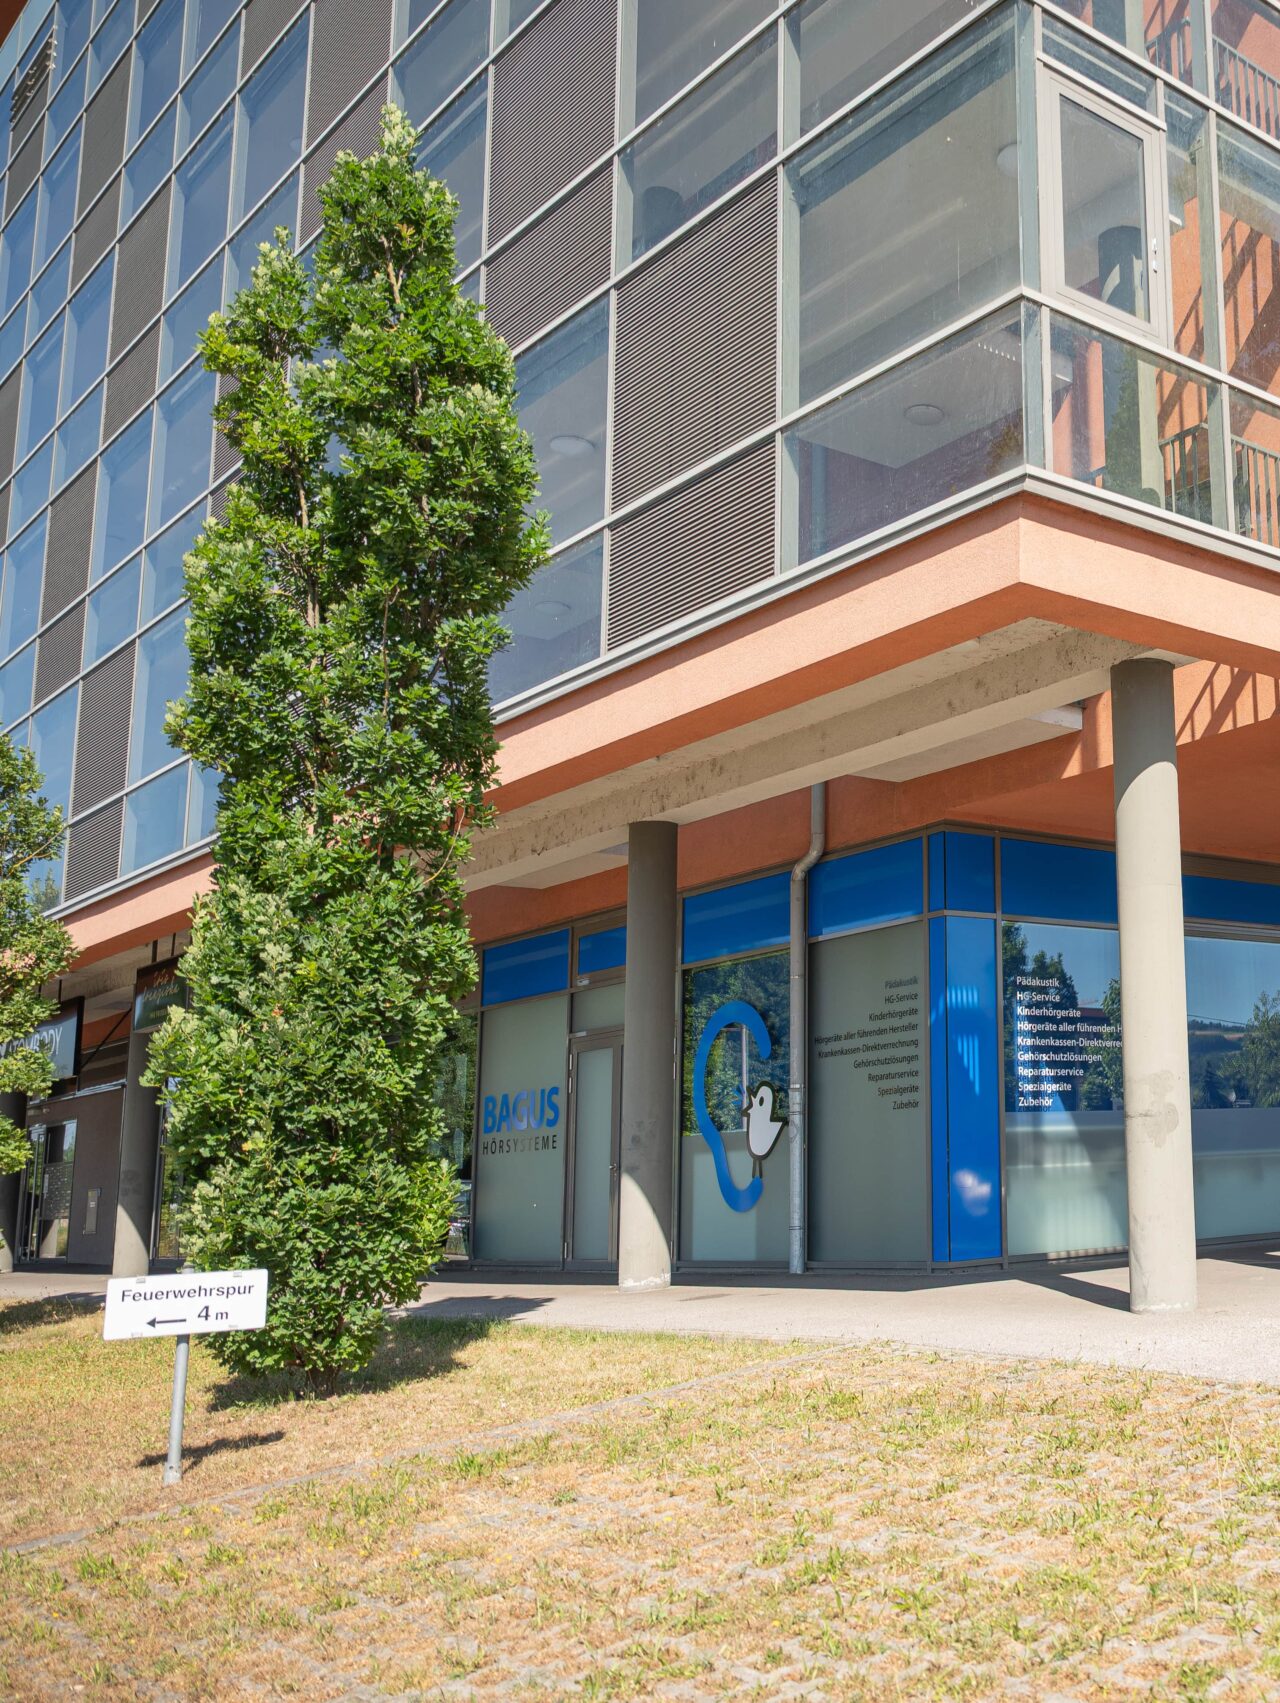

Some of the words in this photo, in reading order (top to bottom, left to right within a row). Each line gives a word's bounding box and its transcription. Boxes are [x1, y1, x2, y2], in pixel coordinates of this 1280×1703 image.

[1016, 976, 1060, 987] Pädakustik
[885, 992, 919, 1005] HG-Service
[1016, 991, 1060, 1002] HG-Service
[868, 1007, 919, 1022] Kinderhörgeräte
[1017, 1006, 1081, 1019] Kinderhörgeräte
[843, 1031, 857, 1041] aller
[857, 1027, 888, 1039] führenden
[888, 1022, 919, 1034] Hersteller
[1017, 1021, 1057, 1033] Hörgeräte
[1058, 1022, 1076, 1032] aller
[1077, 1022, 1116, 1033] führenden
[818, 1038, 919, 1058] Krankenkassen-Direktverrechnung
[853, 1053, 919, 1069] Gehörschutzlösungen
[1018, 1051, 1102, 1063] Gehörschutzlösungen
[868, 1068, 919, 1082] Reparaturservice
[1018, 1066, 1084, 1078] Reparaturservice
[877, 1084, 919, 1097] Spezialgeräte
[1018, 1082, 1072, 1093] Spezialgeräte
[892, 1098, 919, 1110] Zubehör
[1018, 1097, 1053, 1107] Zubehör
[483, 1087, 560, 1134] BAGUS
[482, 1135, 557, 1155] HÖRSYSTEME
[121, 1284, 255, 1302] Feuerwehrspur
[197, 1305, 211, 1321] 4
[215, 1311, 229, 1321] m
